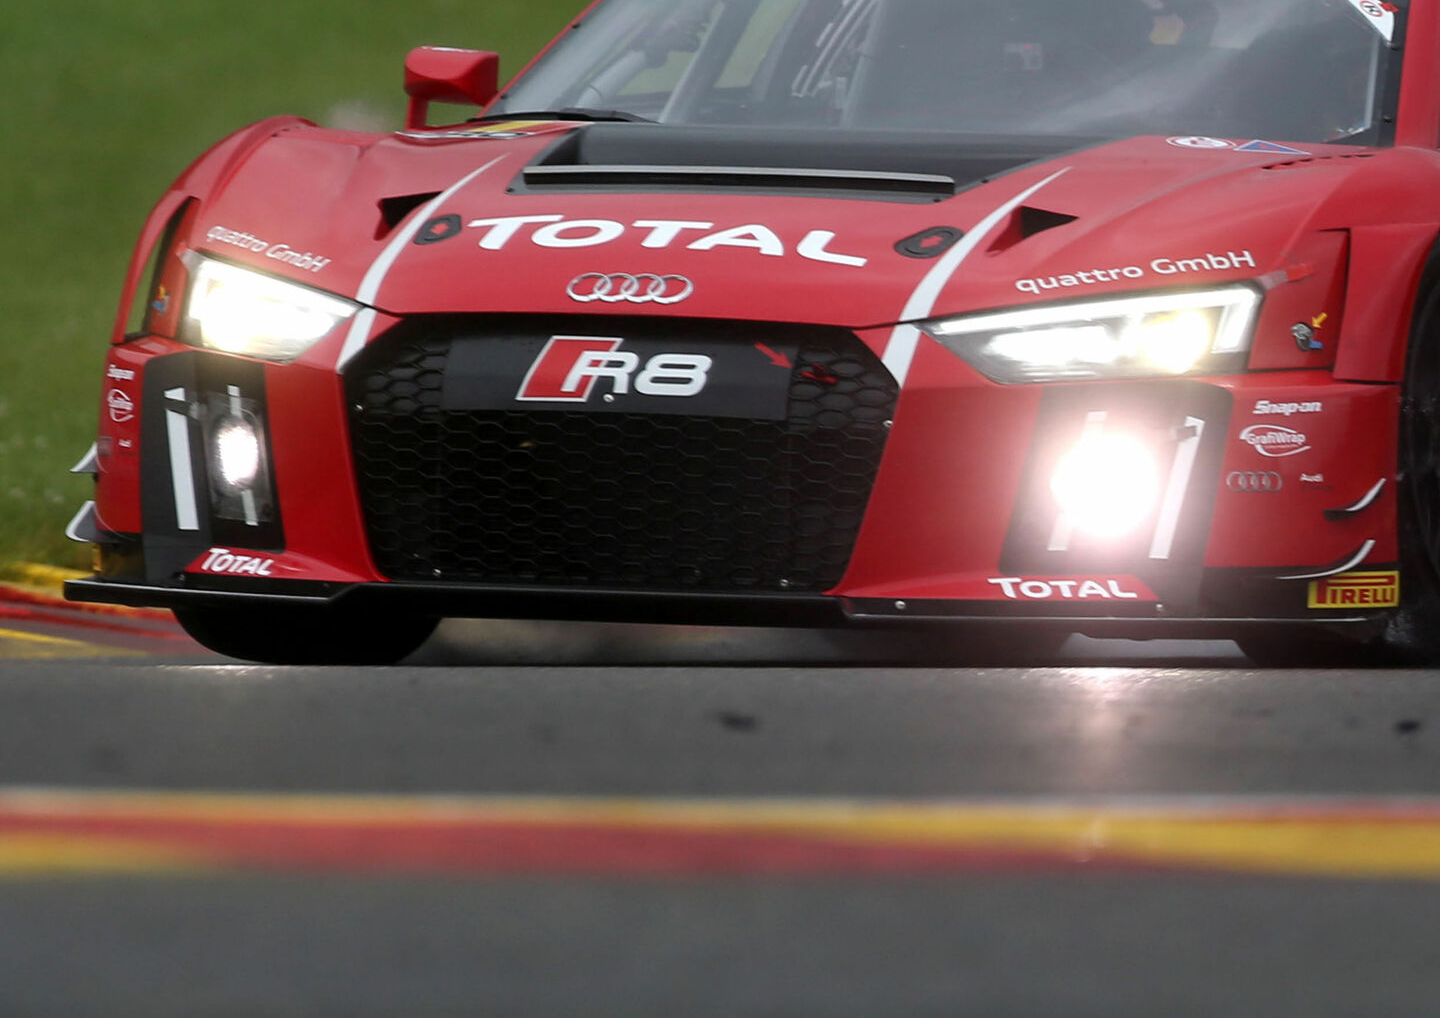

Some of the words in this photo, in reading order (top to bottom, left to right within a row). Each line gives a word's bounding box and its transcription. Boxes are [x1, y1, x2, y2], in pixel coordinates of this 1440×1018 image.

[205, 225, 269, 253] quattro
[265, 243, 333, 273] GmbH
[467, 214, 868, 267] TOTAL
[1015, 266, 1144, 294] quattro
[1150, 250, 1256, 275] GmbH
[560, 350, 713, 397] R8
[1252, 399, 1322, 416] Snap-on
[201, 547, 275, 576] TOTAL
[987, 577, 1138, 599] TOTAL
[1316, 574, 1396, 604] PIRELLI
